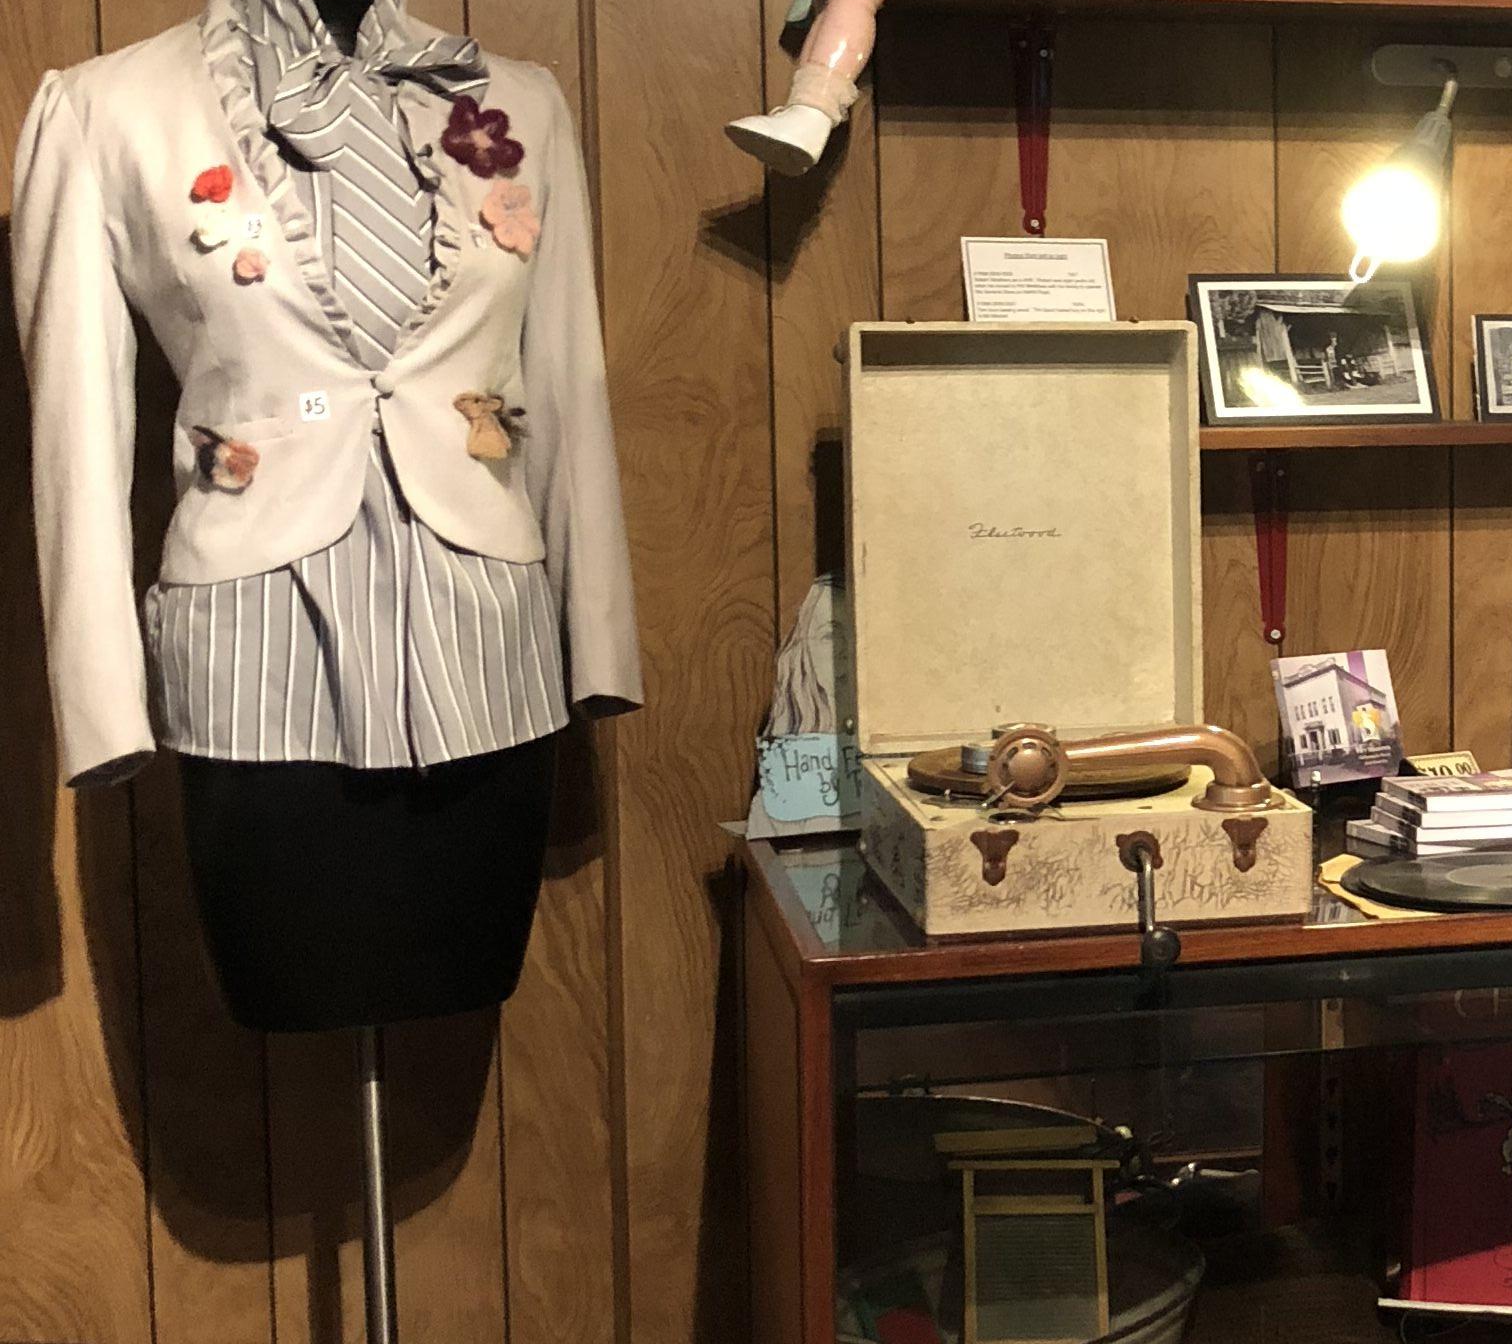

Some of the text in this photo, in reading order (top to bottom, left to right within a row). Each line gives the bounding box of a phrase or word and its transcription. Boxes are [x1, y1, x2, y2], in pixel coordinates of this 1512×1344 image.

[305, 396, 326, 415] $5
[783, 747, 834, 782] Hand
[819, 771, 839, 807] by
